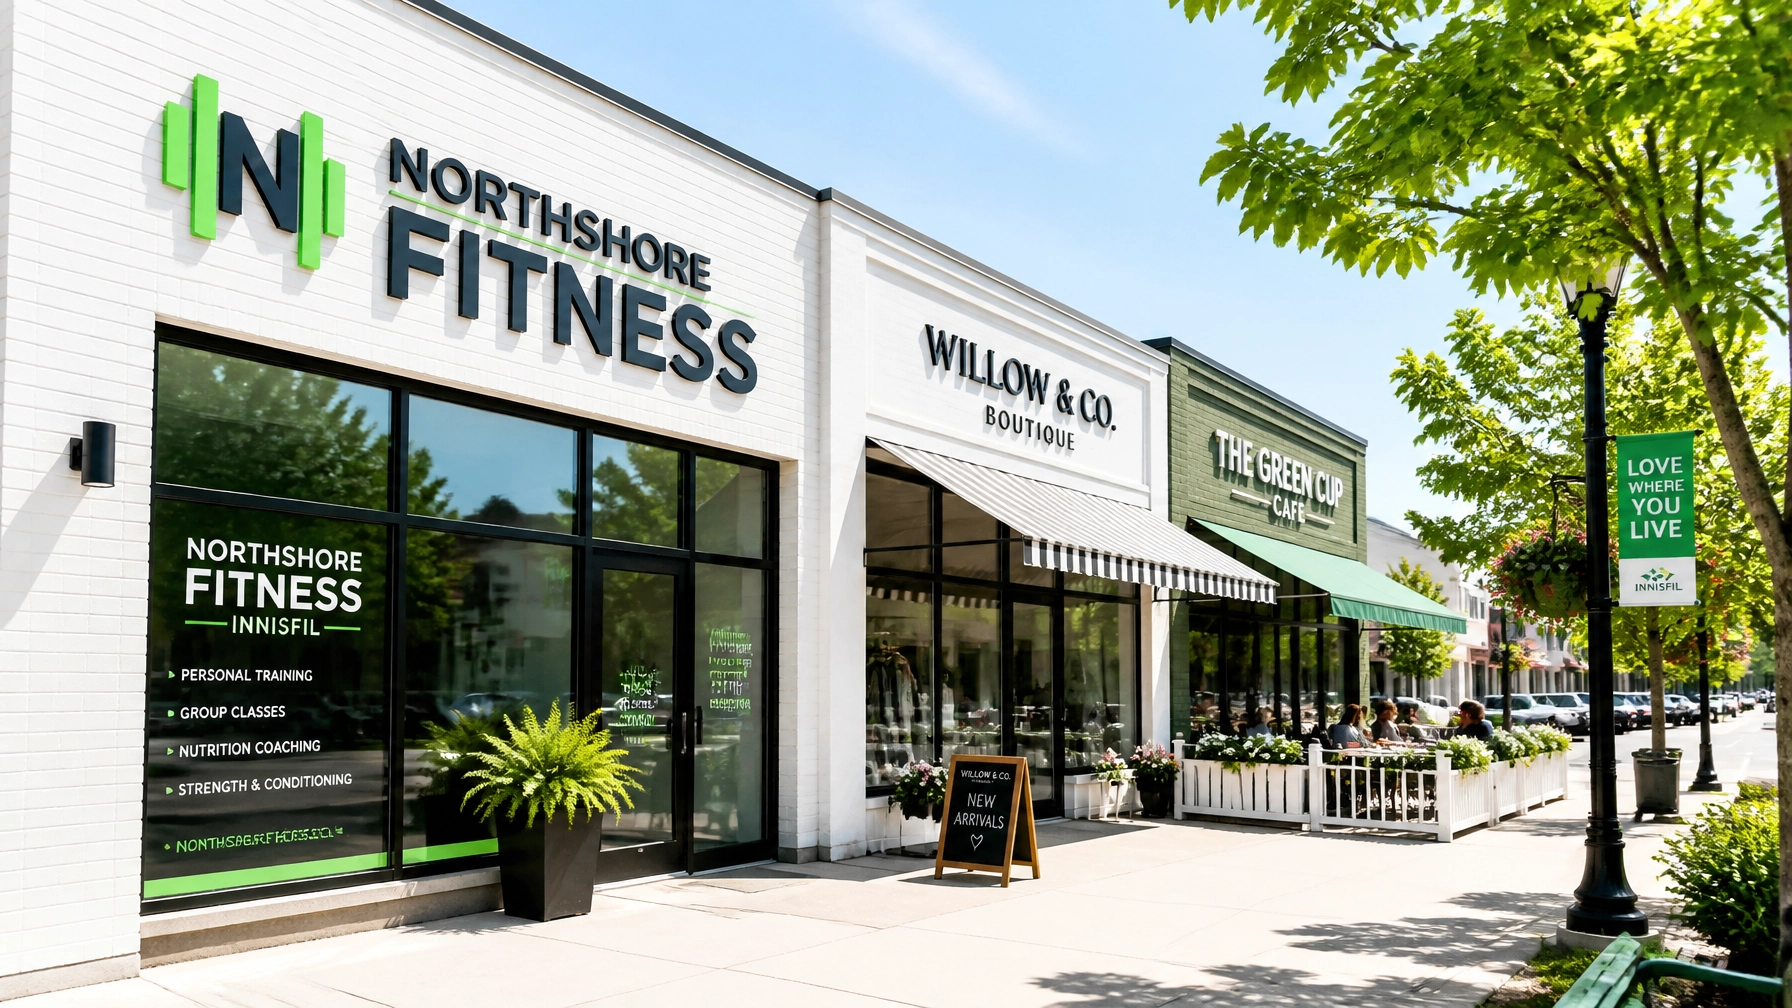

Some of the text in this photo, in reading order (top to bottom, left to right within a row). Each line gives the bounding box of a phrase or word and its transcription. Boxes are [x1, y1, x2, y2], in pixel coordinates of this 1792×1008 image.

[389, 137, 712, 292] NORTHSHORE
[386, 205, 758, 395] FITNESS
[924, 323, 1117, 432] WILLOW & CO.
[985, 404, 1075, 451] BOUTIQUE
[1215, 428, 1343, 508] THE GREEN CUP
[1627, 456, 1683, 477] LOVE
[1627, 478, 1685, 494] WHERE
[1272, 494, 1306, 524] CAFE
[1631, 496, 1681, 516] YOU
[1630, 519, 1683, 540] LIVE
[187, 537, 363, 573] NORTHSHORE
[185, 567, 363, 613] FITNESS
[1634, 582, 1684, 592] INNISFIL
[232, 614, 321, 637] INNISFIL
[180, 668, 313, 682] PERSONAL TRAINING
[180, 705, 286, 720] GROUP CLASSES
[178, 739, 321, 758] NUTRITION COACHING
[178, 773, 353, 796] STRENGTH & CONDITIONING
[960, 769, 992, 779] WILLOW
[998, 771, 1011, 781] CO.
[967, 792, 997, 809] NEW
[953, 811, 1005, 830] ARRIVALS
